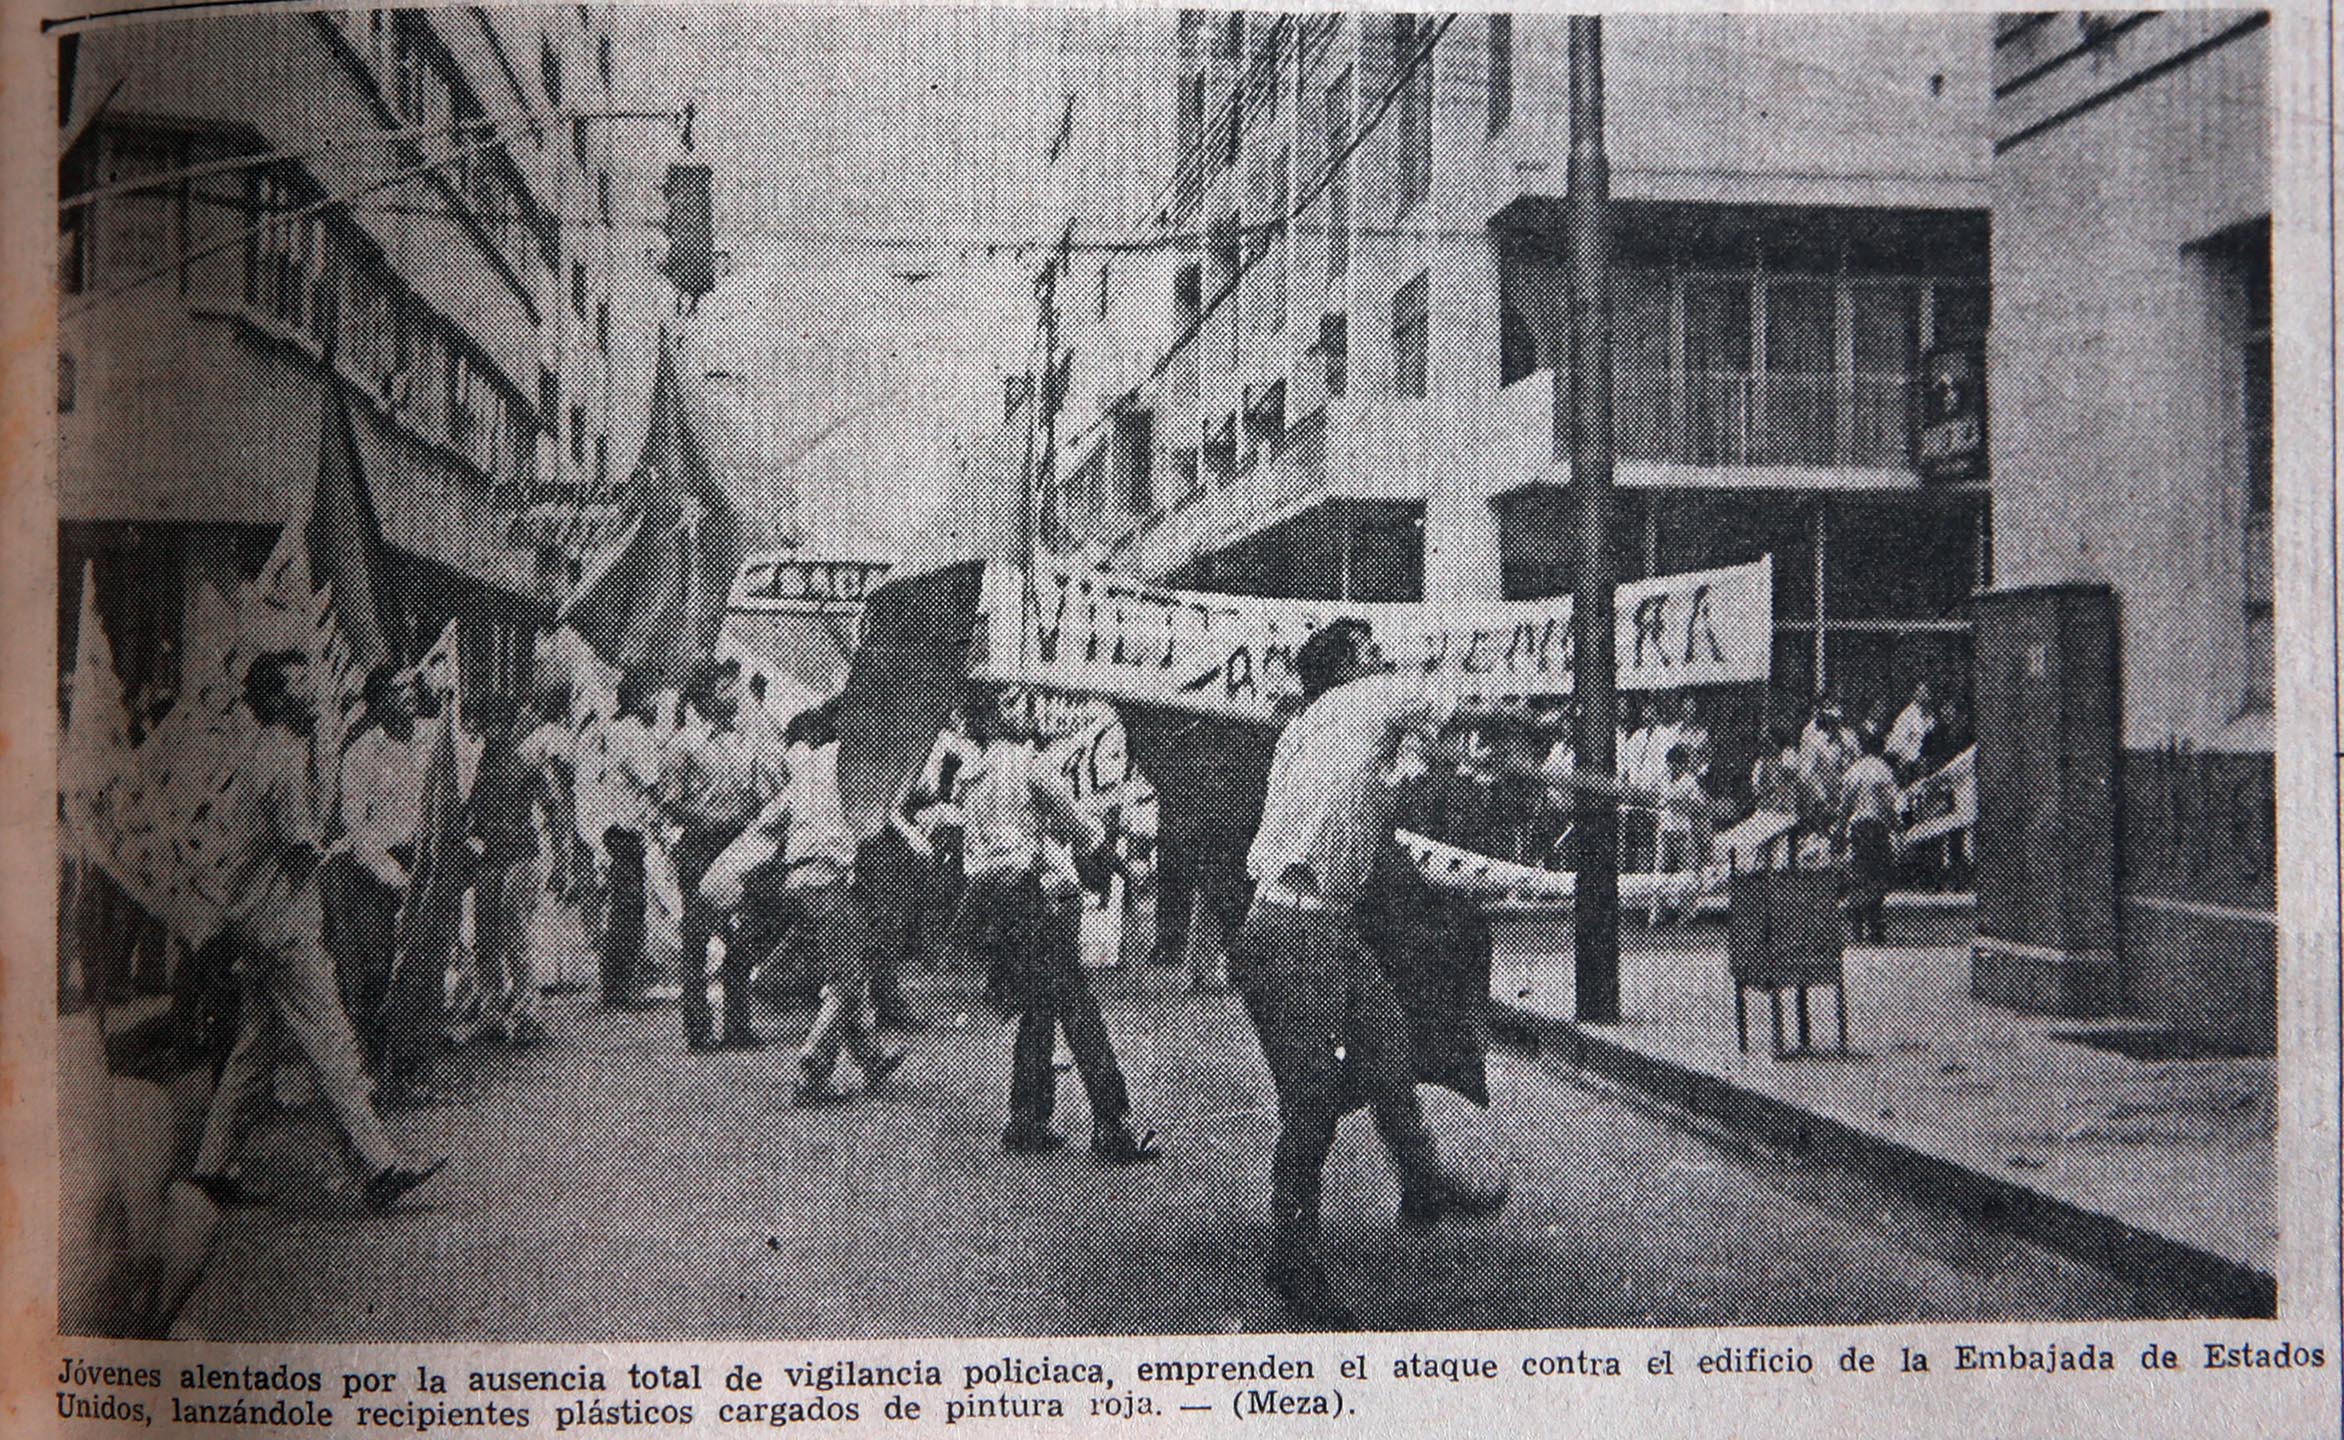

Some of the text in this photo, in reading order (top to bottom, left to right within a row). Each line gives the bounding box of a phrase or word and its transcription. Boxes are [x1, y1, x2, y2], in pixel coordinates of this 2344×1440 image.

[58, 1342, 2326, 1399] Jóvenes alentados por la ausencia total de vigilancia policiaca, emprenden el ataque contra el edificio de la Embajada de Estados
[56, 1392, 152, 1427] Unidos,
[172, 1398, 333, 1427] lanzándole
[357, 1401, 530, 1432] recipientes
[555, 1398, 693, 1431] plásticos
[719, 1396, 859, 1427] cargados
[884, 1395, 921, 1420] de
[945, 1392, 1064, 1425] pintura
[1090, 1390, 1162, 1419] roja.
[1233, 1389, 1356, 1421] (Meza).
